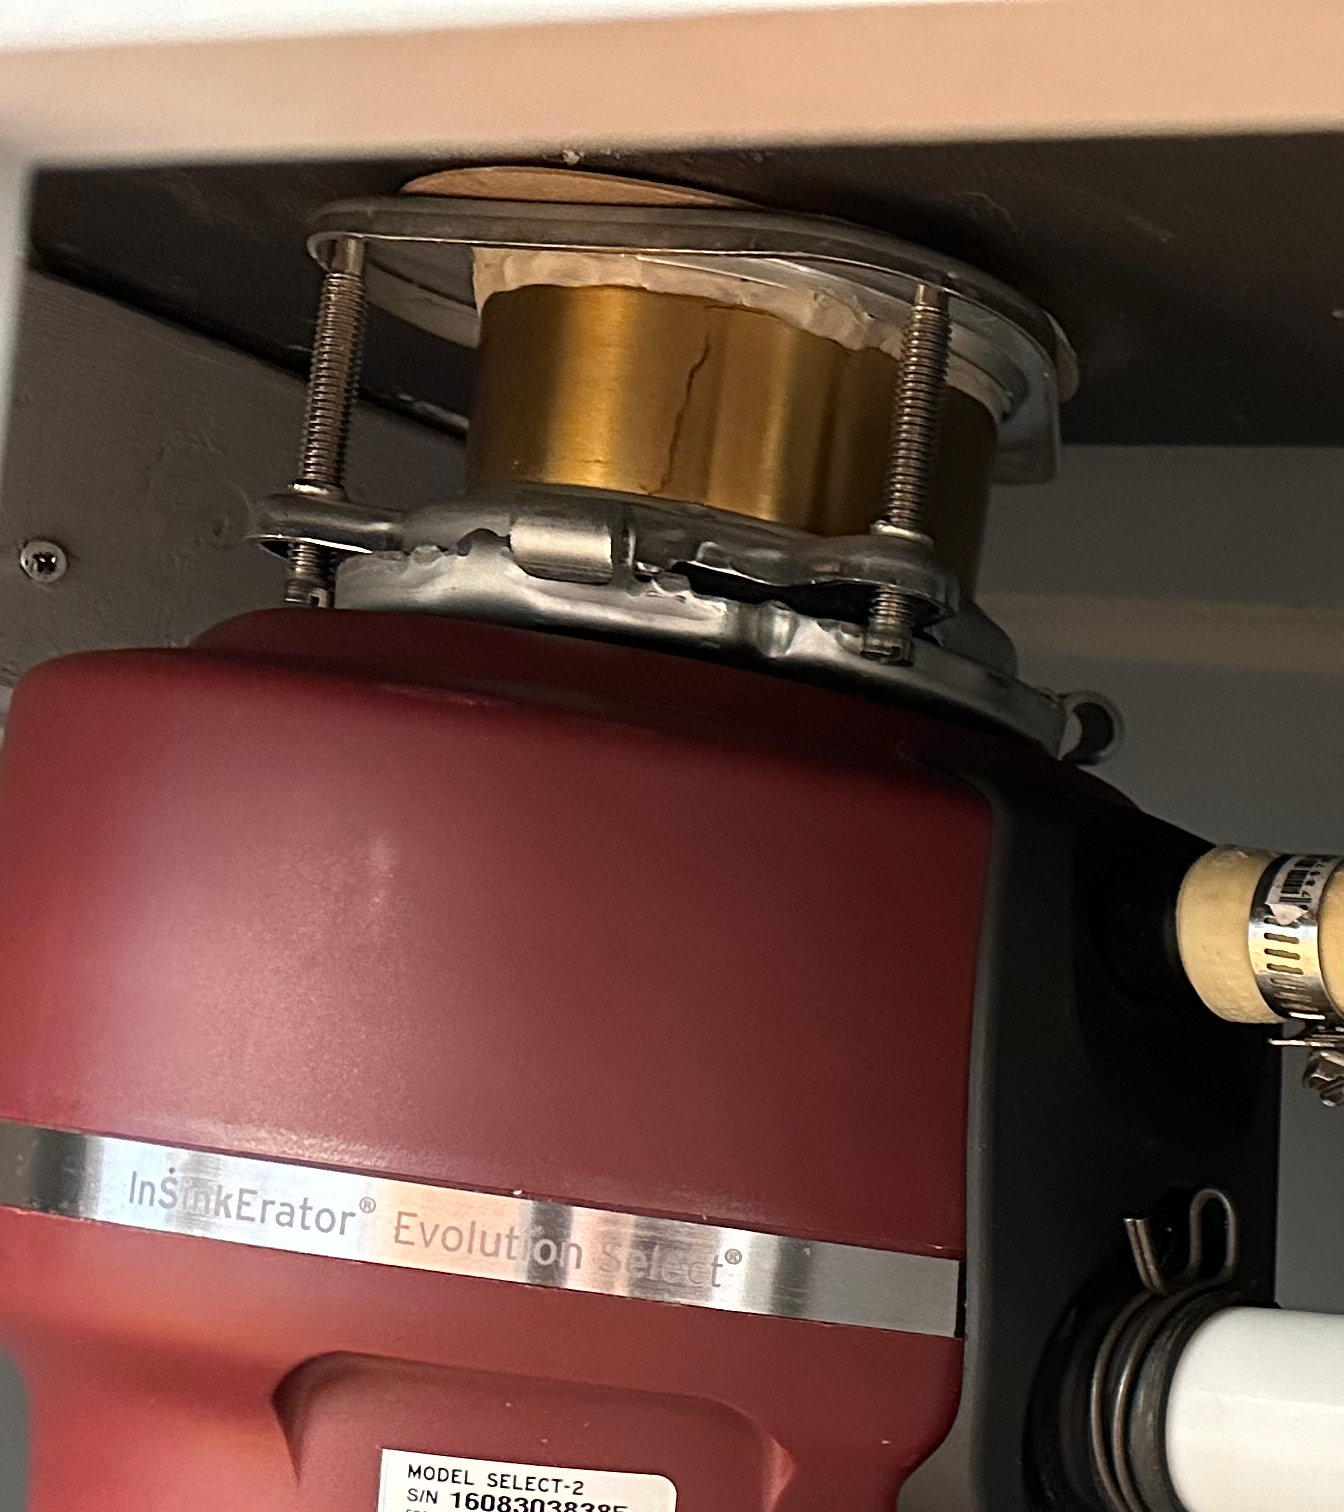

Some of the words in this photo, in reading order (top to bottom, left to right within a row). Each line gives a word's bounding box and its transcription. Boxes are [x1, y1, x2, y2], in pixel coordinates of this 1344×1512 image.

[393, 1210, 583, 1270] Evolution
[407, 1463, 475, 1486] MODEL
[487, 1472, 585, 1496] SELECT-2
[406, 1488, 439, 1505] S/N
